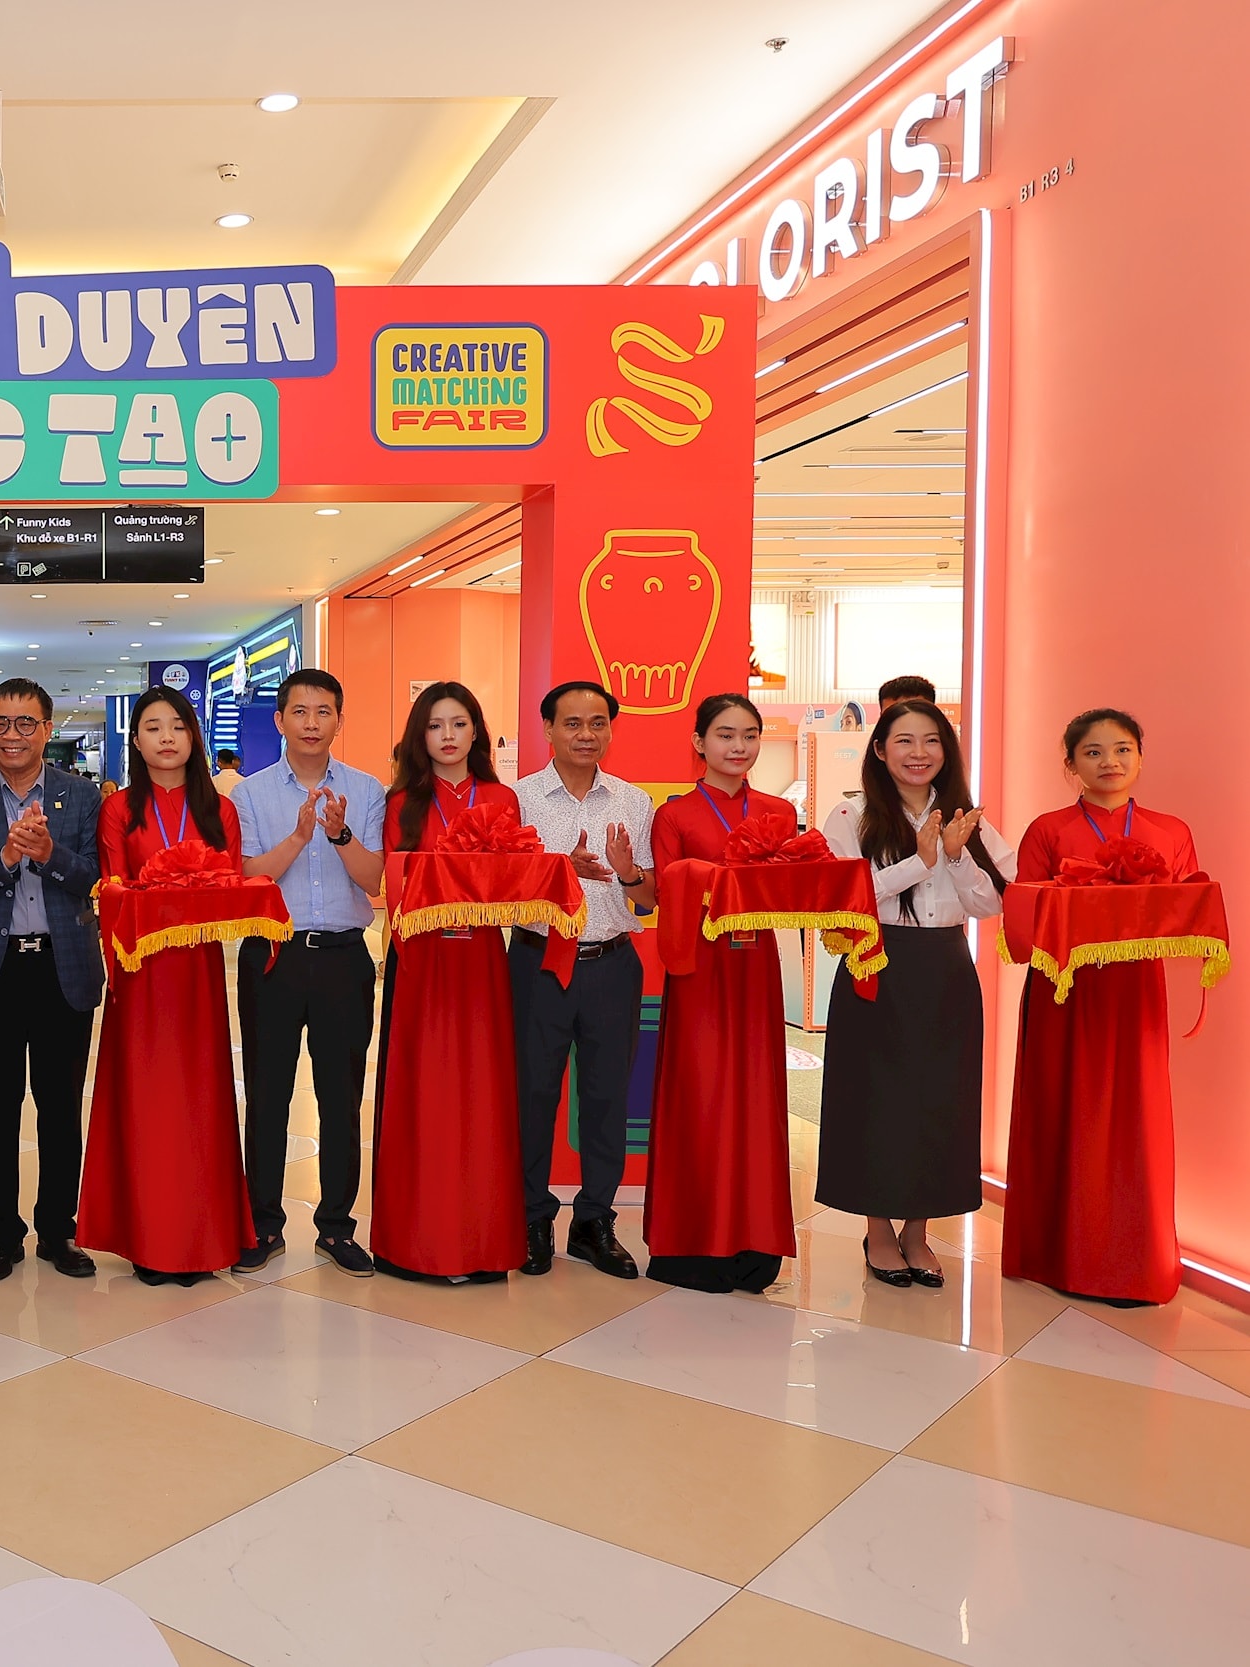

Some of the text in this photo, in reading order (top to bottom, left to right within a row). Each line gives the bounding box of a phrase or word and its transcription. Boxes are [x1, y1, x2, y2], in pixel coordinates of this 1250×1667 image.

[1020, 157, 1074, 204] B1 R3 4
[15, 282, 315, 375] DUYÊN
[392, 409, 527, 431] FAIR
[48, 392, 263, 486] TẠO
[16, 517, 71, 529] Funny Kids
[114, 515, 183, 527] Quảng trường
[16, 531, 97, 543] Khu đỗ xe B1-R1
[126, 532, 185, 542] Sảnh L1-R3
